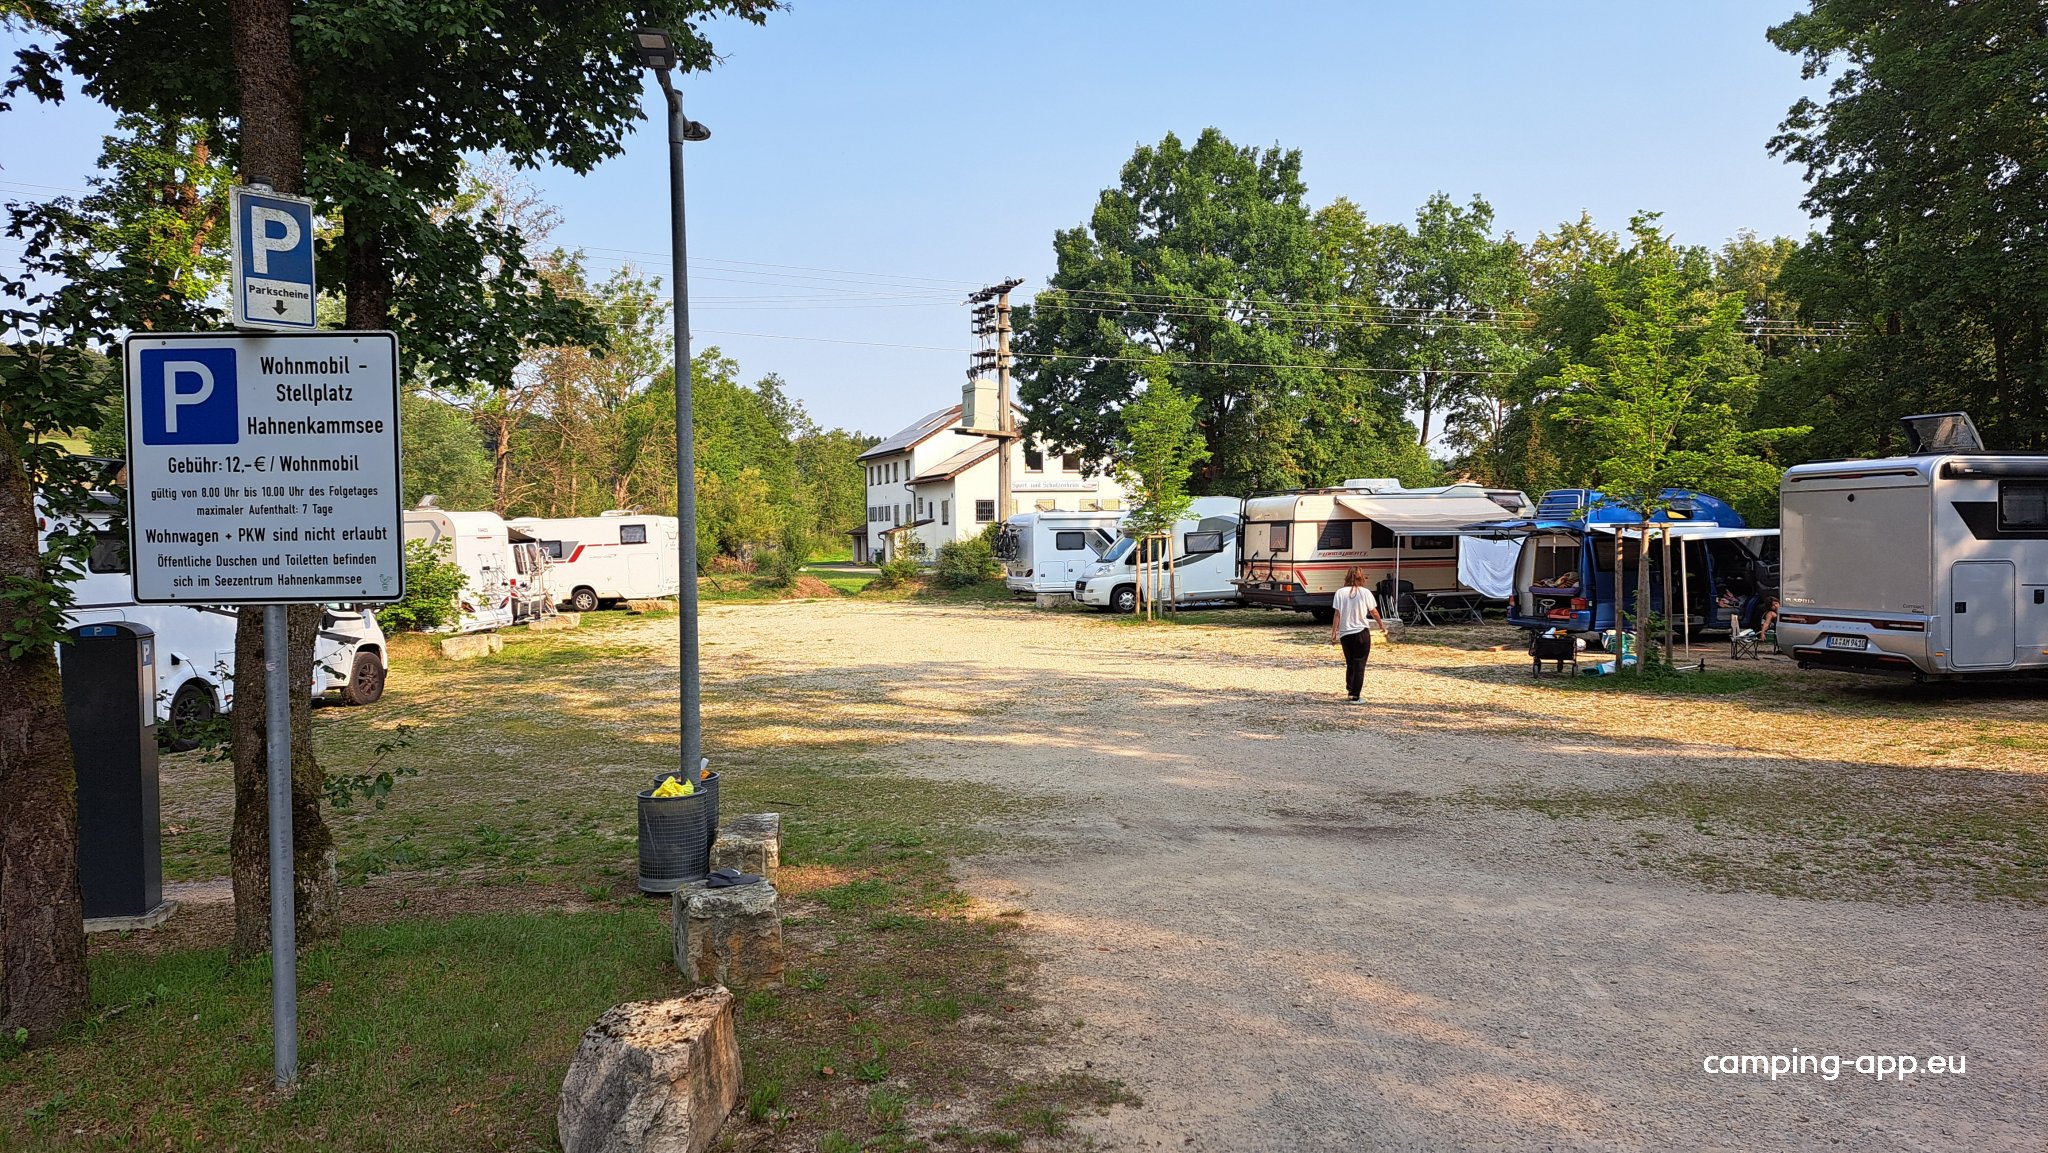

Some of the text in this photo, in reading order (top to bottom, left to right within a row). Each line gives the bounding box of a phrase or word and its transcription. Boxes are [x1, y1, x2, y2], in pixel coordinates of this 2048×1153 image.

[251, 205, 300, 274] P
[248, 284, 309, 300] Parkscheine
[260, 356, 350, 375] Wohnmobil
[163, 360, 215, 434] P
[276, 384, 353, 406] Stellplatz
[247, 416, 384, 435] Hahnenkammsee
[168, 456, 223, 473] Gebühr:
[279, 455, 359, 472] Wohnmobil
[151, 486, 378, 501] gültig von 8.00 Uhr bis 10.00 Uhr des Folgetages
[196, 503, 333, 516] maximaler Aufenthalt: 7 Tage
[145, 528, 219, 546] Wohnwagen
[238, 527, 266, 542] PKW
[272, 527, 299, 542] sind
[304, 526, 336, 541] nicht
[342, 526, 388, 541] erlaubt
[157, 553, 377, 568] Öffentliche Duschen und Toiletten befinden
[173, 573, 362, 587] sich im Seezentrum Hahnenkammsee
